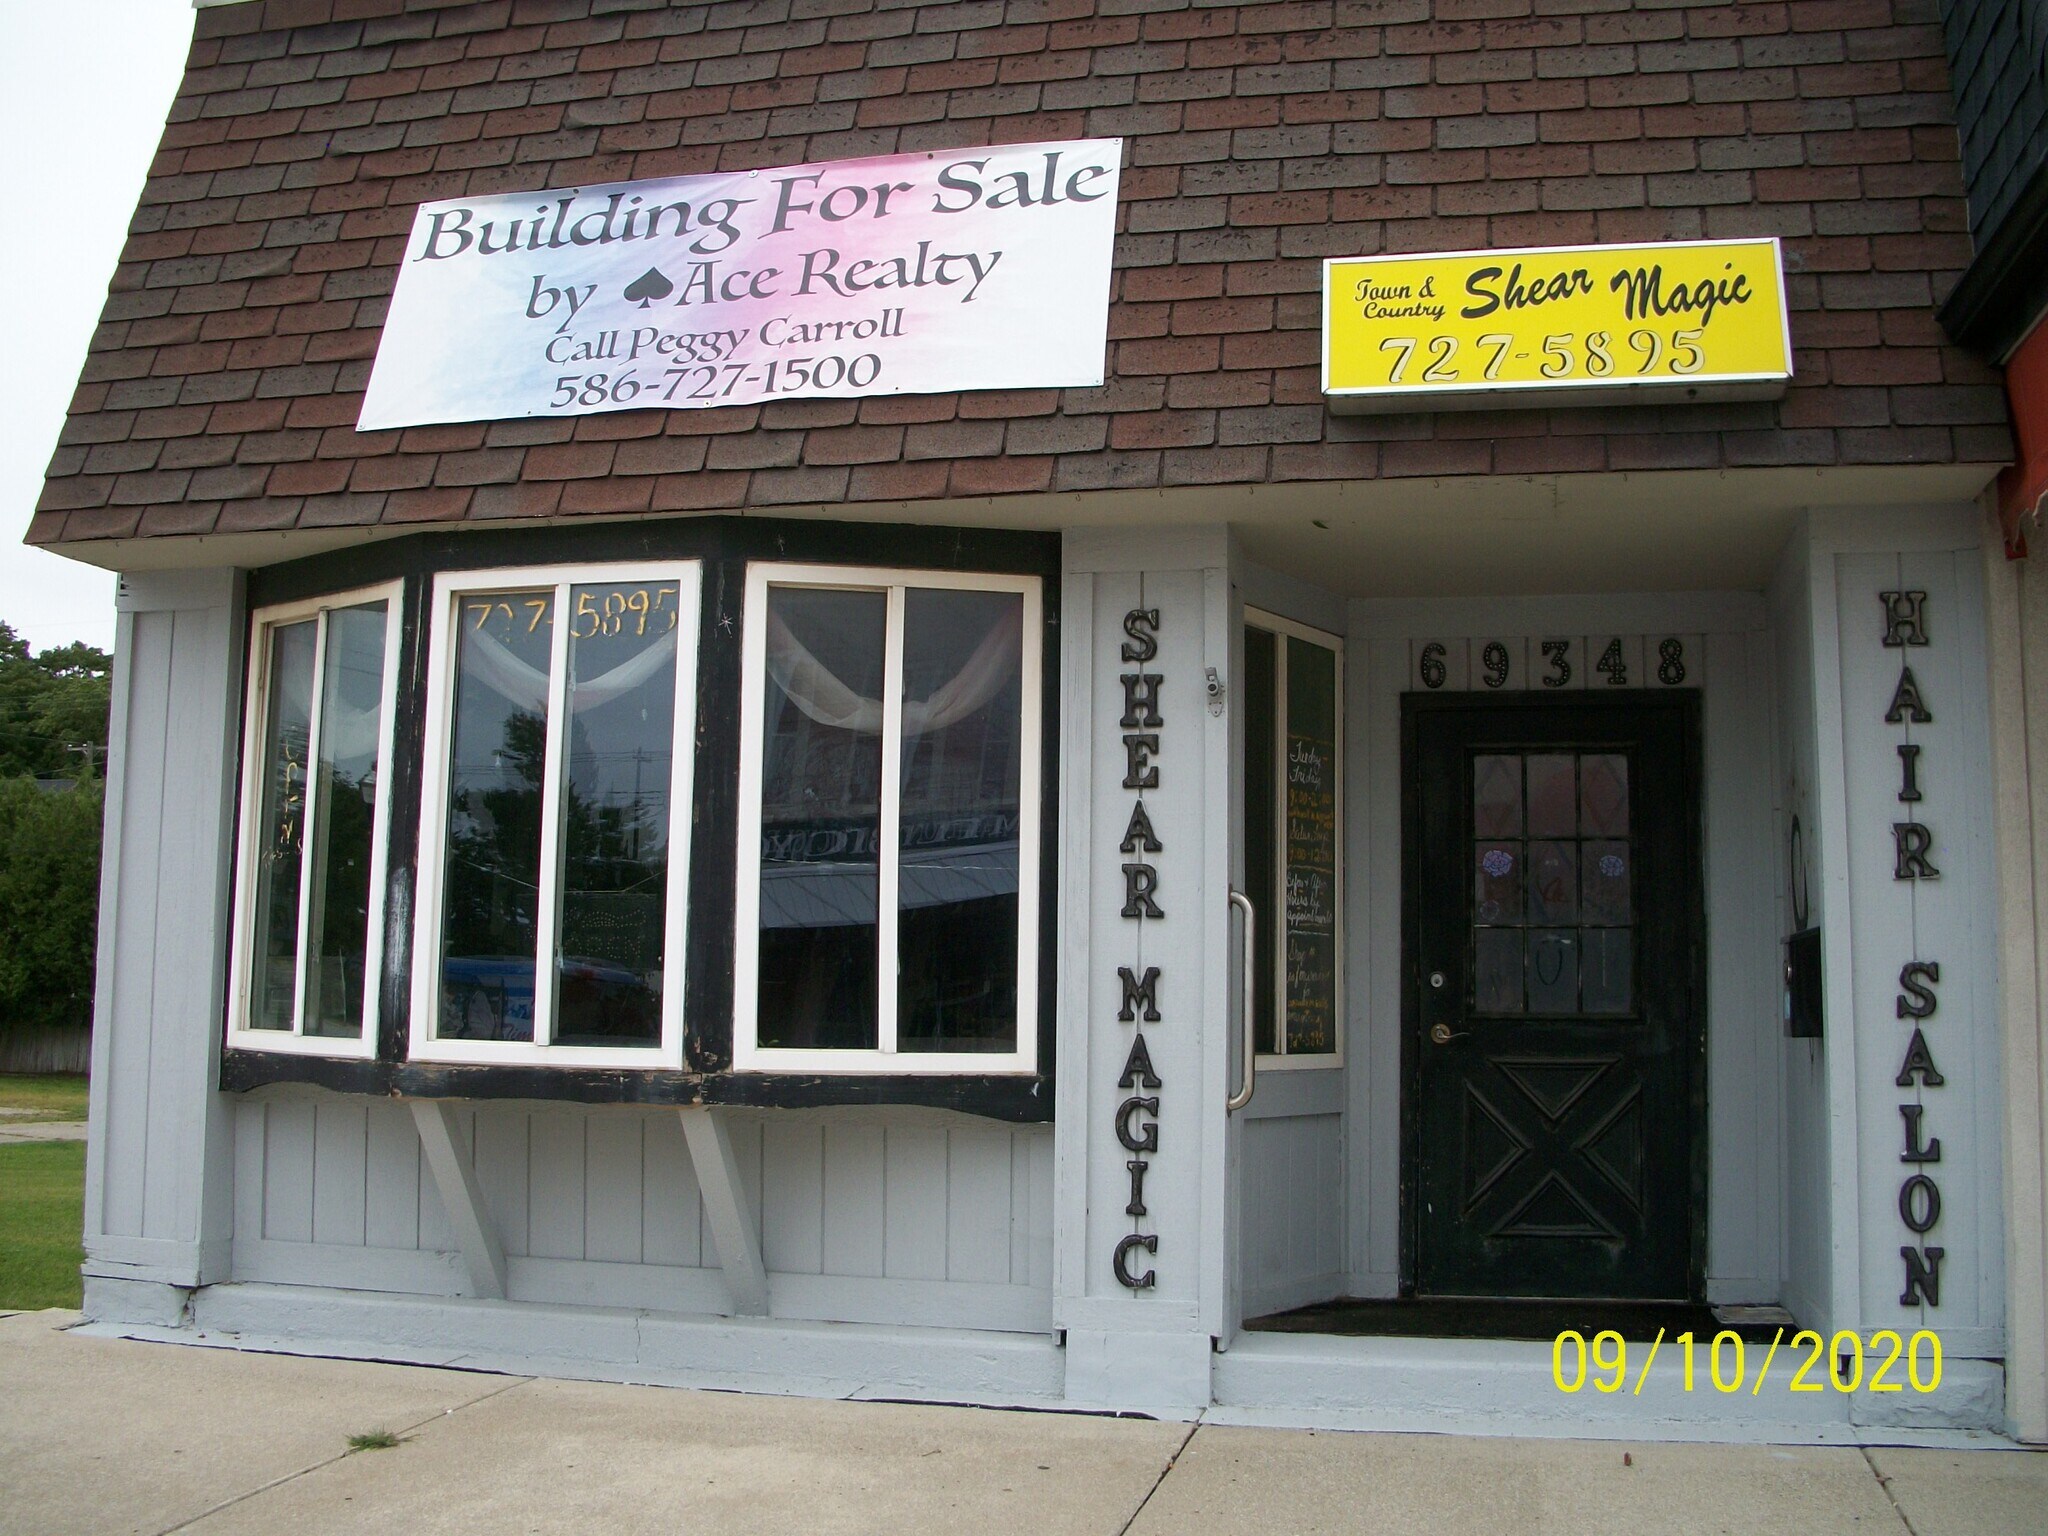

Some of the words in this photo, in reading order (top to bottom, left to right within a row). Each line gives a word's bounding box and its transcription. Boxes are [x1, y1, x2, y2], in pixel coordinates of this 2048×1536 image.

[413, 190, 757, 263] Building
[757, 167, 915, 238] For
[931, 151, 1110, 214] Sale
[525, 274, 598, 334] by
[674, 259, 780, 307] Ace
[799, 240, 1002, 303] Realty
[1354, 277, 1411, 303] Town
[1418, 275, 1436, 299] &
[1362, 301, 1446, 322] Country
[1460, 262, 1594, 320] Shear
[1610, 262, 1752, 327] Magic
[545, 328, 620, 366] Call
[628, 325, 751, 365] Peggy
[760, 307, 907, 347] Carroll
[1379, 327, 1706, 384] 727-5895
[549, 353, 882, 409] 586-727-1500
[1420, 637, 1686, 689] 69348
[1119, 607, 1165, 919] SHEAR
[1878, 591, 1941, 881] HAIR
[1113, 966, 1163, 1290] MAGIC
[1895, 961, 1945, 1307] SALON
